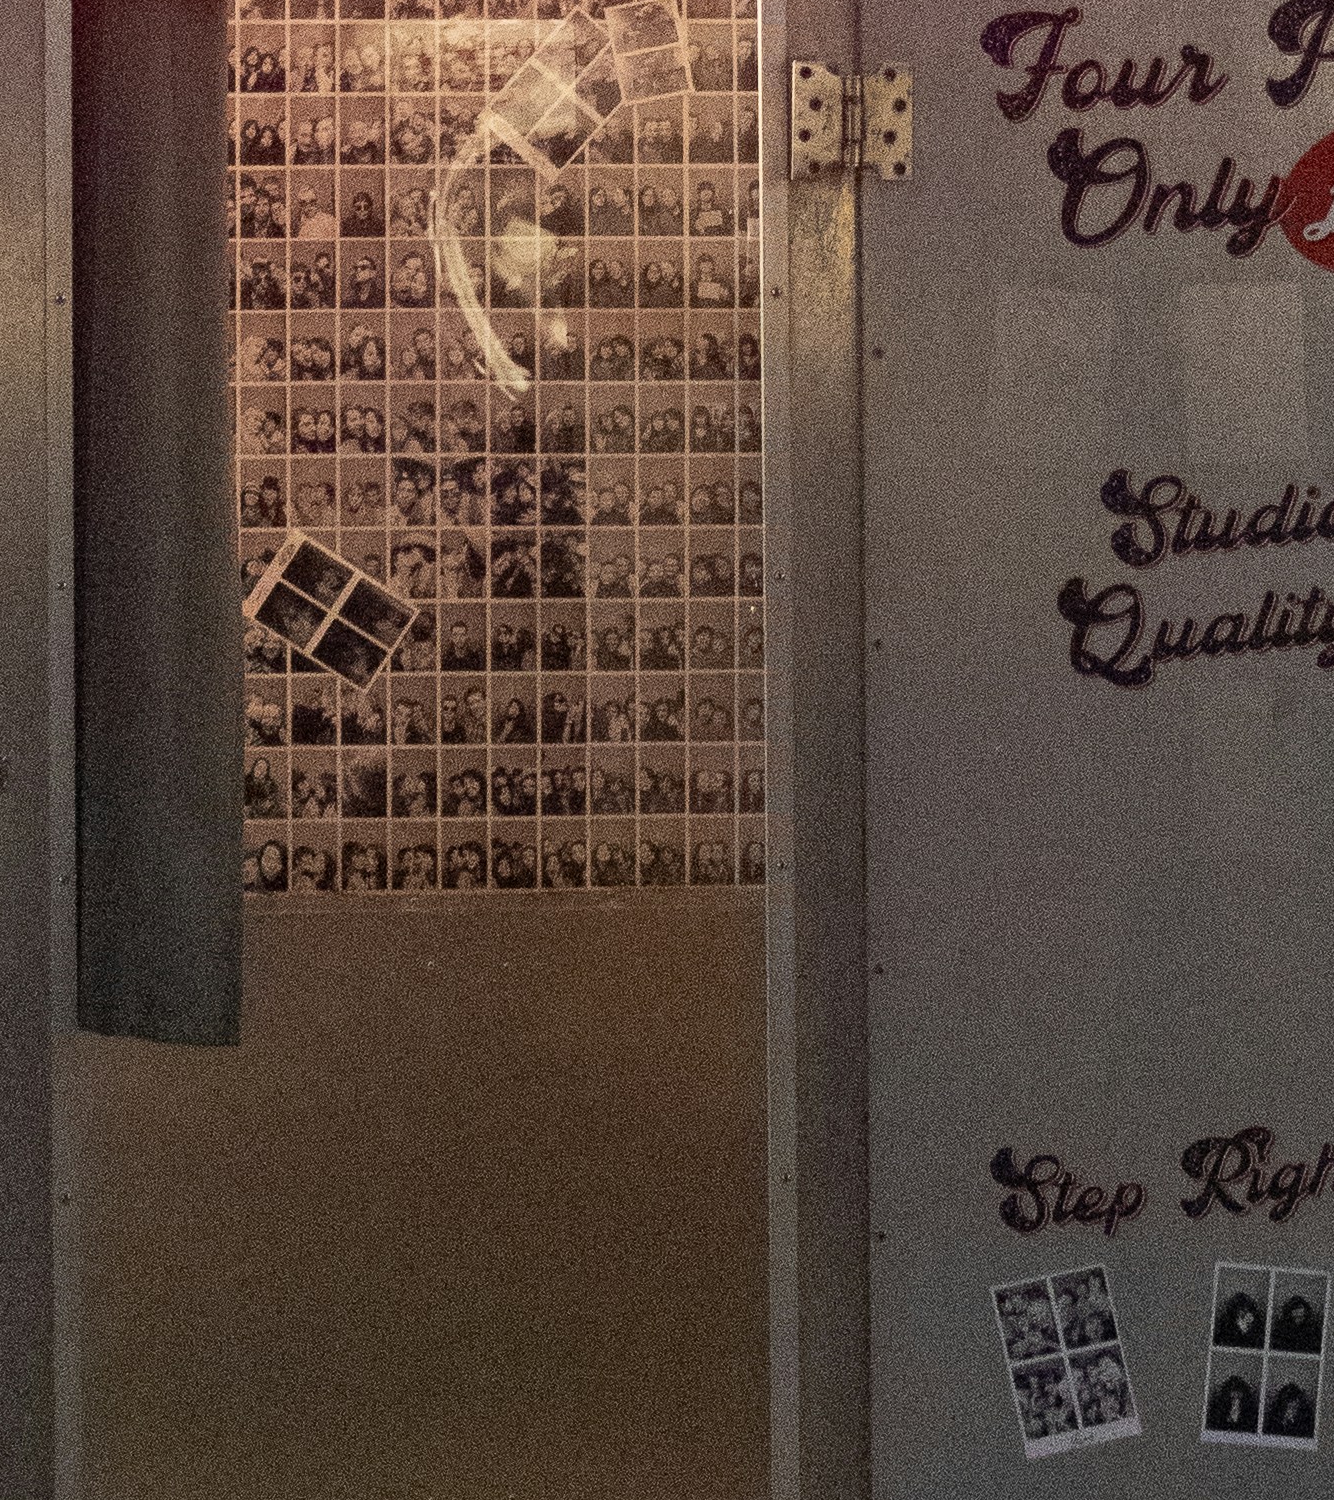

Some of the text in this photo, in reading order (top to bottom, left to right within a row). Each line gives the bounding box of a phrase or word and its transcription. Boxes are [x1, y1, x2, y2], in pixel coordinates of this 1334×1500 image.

[979, 6, 1229, 123] Four
[1047, 126, 1297, 258] Only
[990, 1146, 1148, 1237] Step
